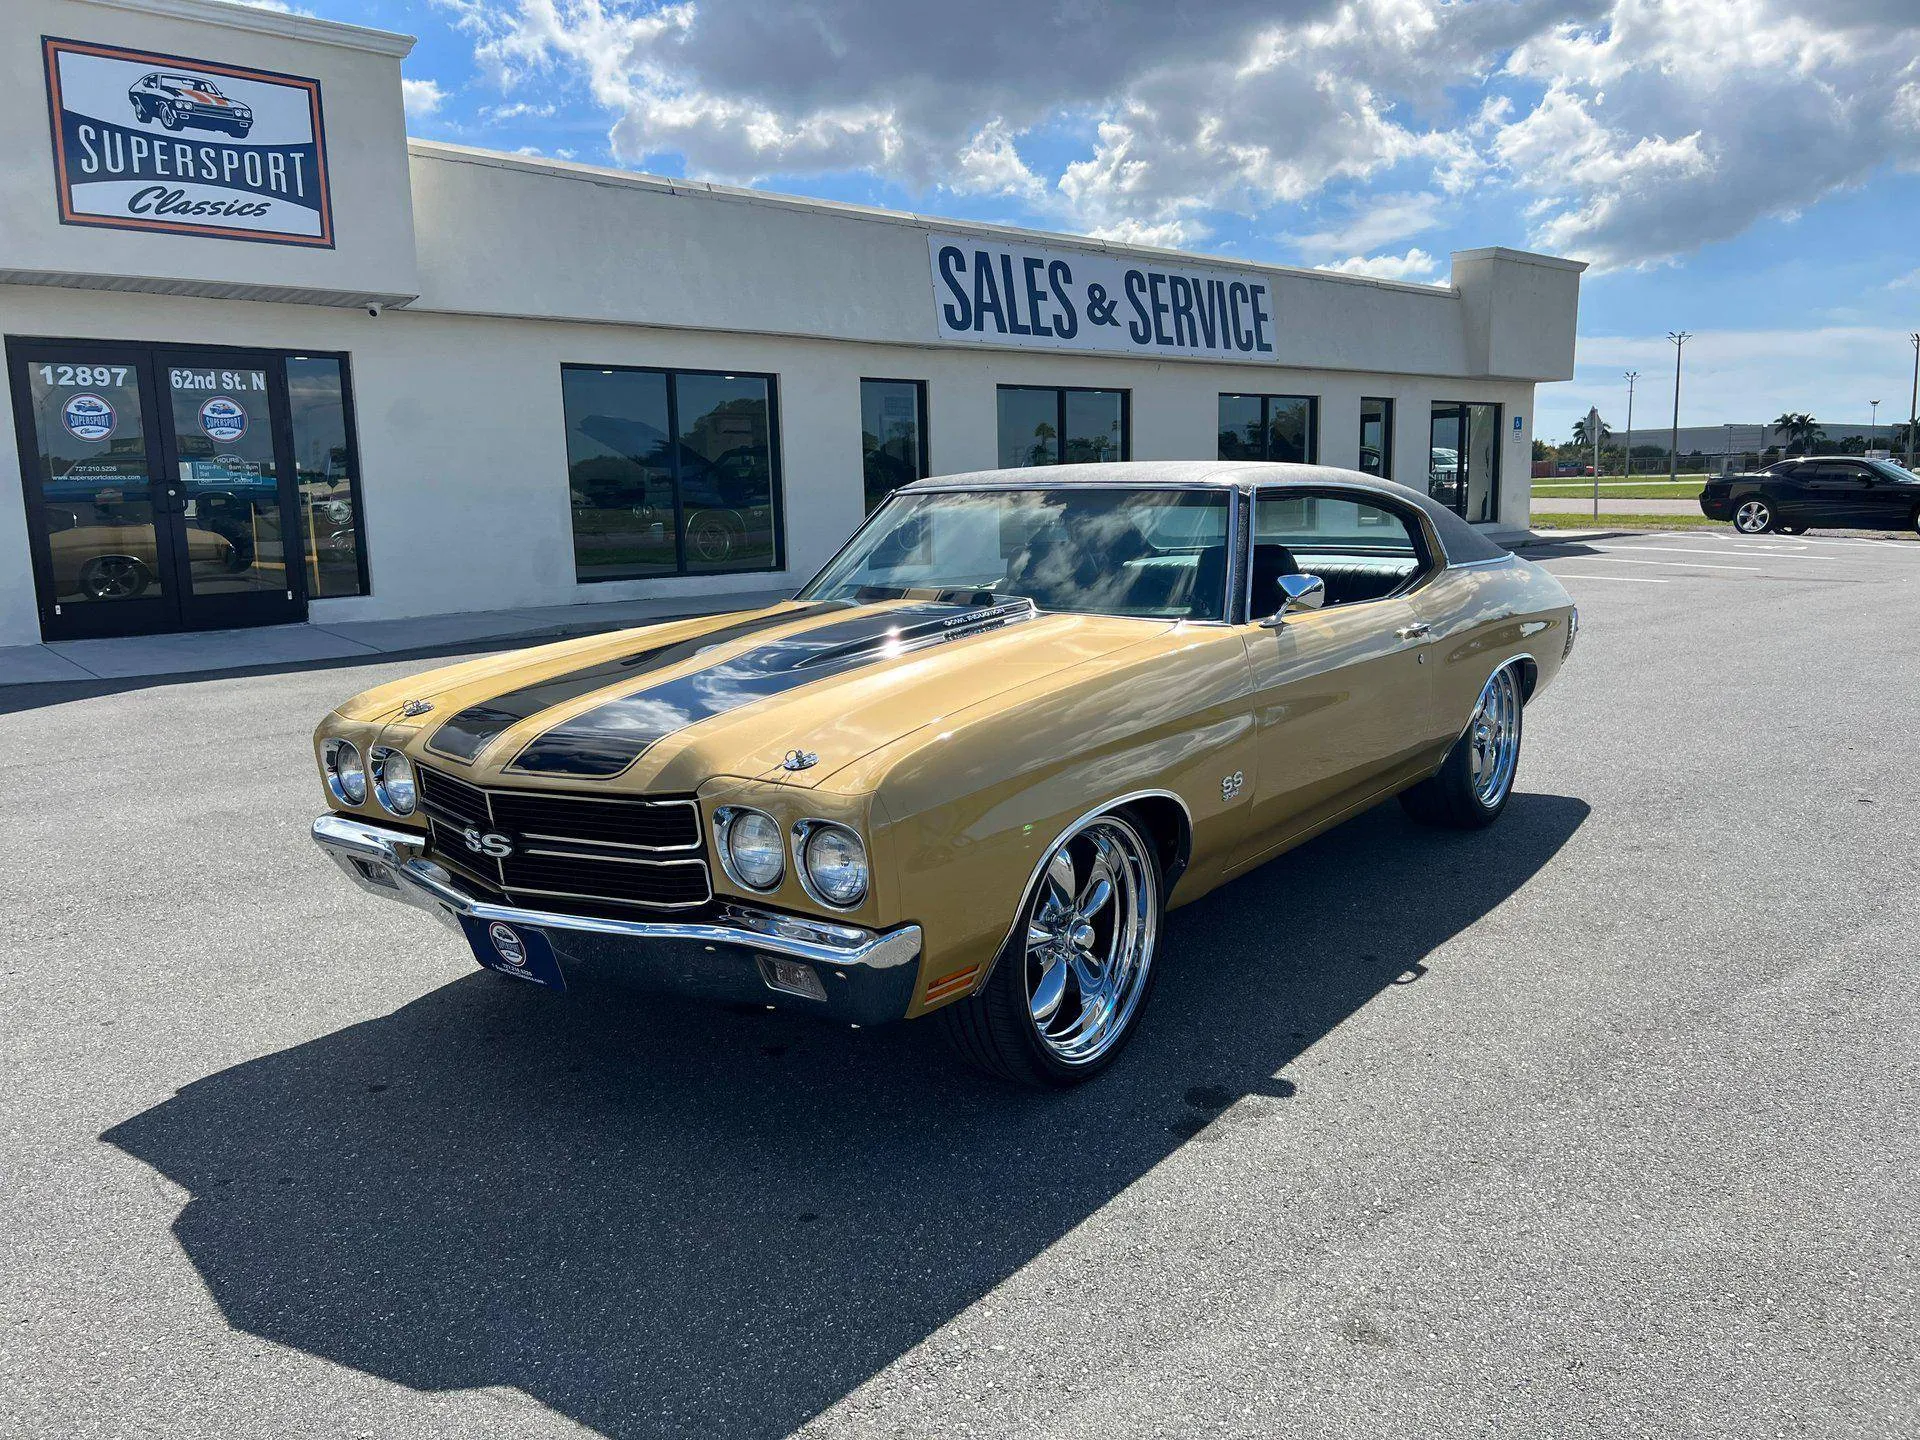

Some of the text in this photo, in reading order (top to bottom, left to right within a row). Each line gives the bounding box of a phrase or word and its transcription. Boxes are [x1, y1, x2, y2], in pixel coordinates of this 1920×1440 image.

[78, 124, 305, 198] SUPERSPORT
[128, 185, 272, 217] Classics
[938, 246, 1273, 353] SALES & SERVICE
[40, 365, 128, 387] 12897
[171, 369, 265, 391] 62nd St. N
[70, 414, 109, 427] SUPERSPORT
[205, 416, 241, 429] SUPERSPORT
[52, 474, 141, 482] www.supersportclassics.com
[1222, 770, 1243, 793] SS
[464, 828, 513, 858] SS
